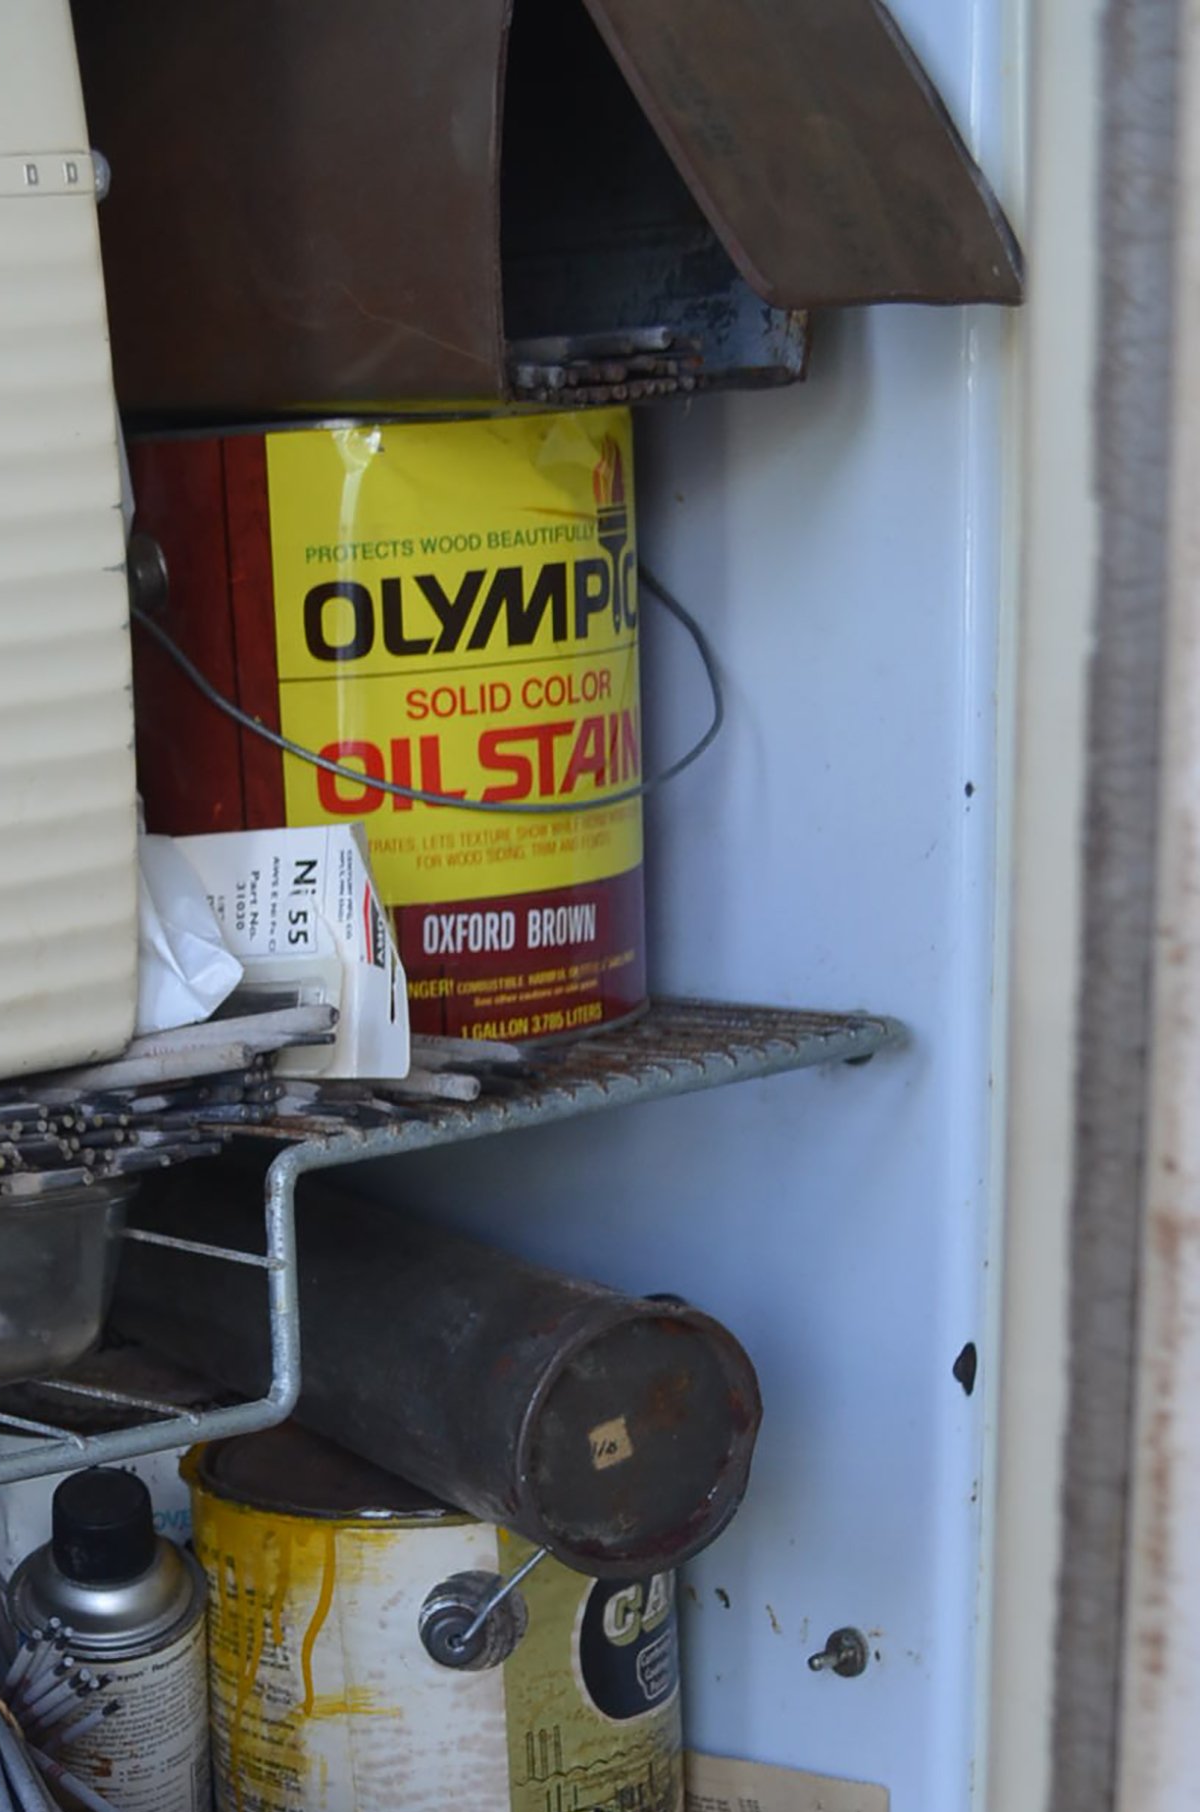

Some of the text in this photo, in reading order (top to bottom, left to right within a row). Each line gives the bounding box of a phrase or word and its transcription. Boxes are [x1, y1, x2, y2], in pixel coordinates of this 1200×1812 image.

[305, 523, 596, 563] PROTECTS WOOD BEAUTIFULLY
[405, 669, 611, 720] SOLID COLOR
[317, 707, 640, 815] OIL STAIN
[249, 869, 260, 905] Part
[287, 859, 318, 945] Ni 55
[423, 910, 515, 956] OXFORD
[527, 903, 597, 949] BROWN
[409, 978, 455, 999] NGER!
[473, 1017, 529, 1041] GALLON
